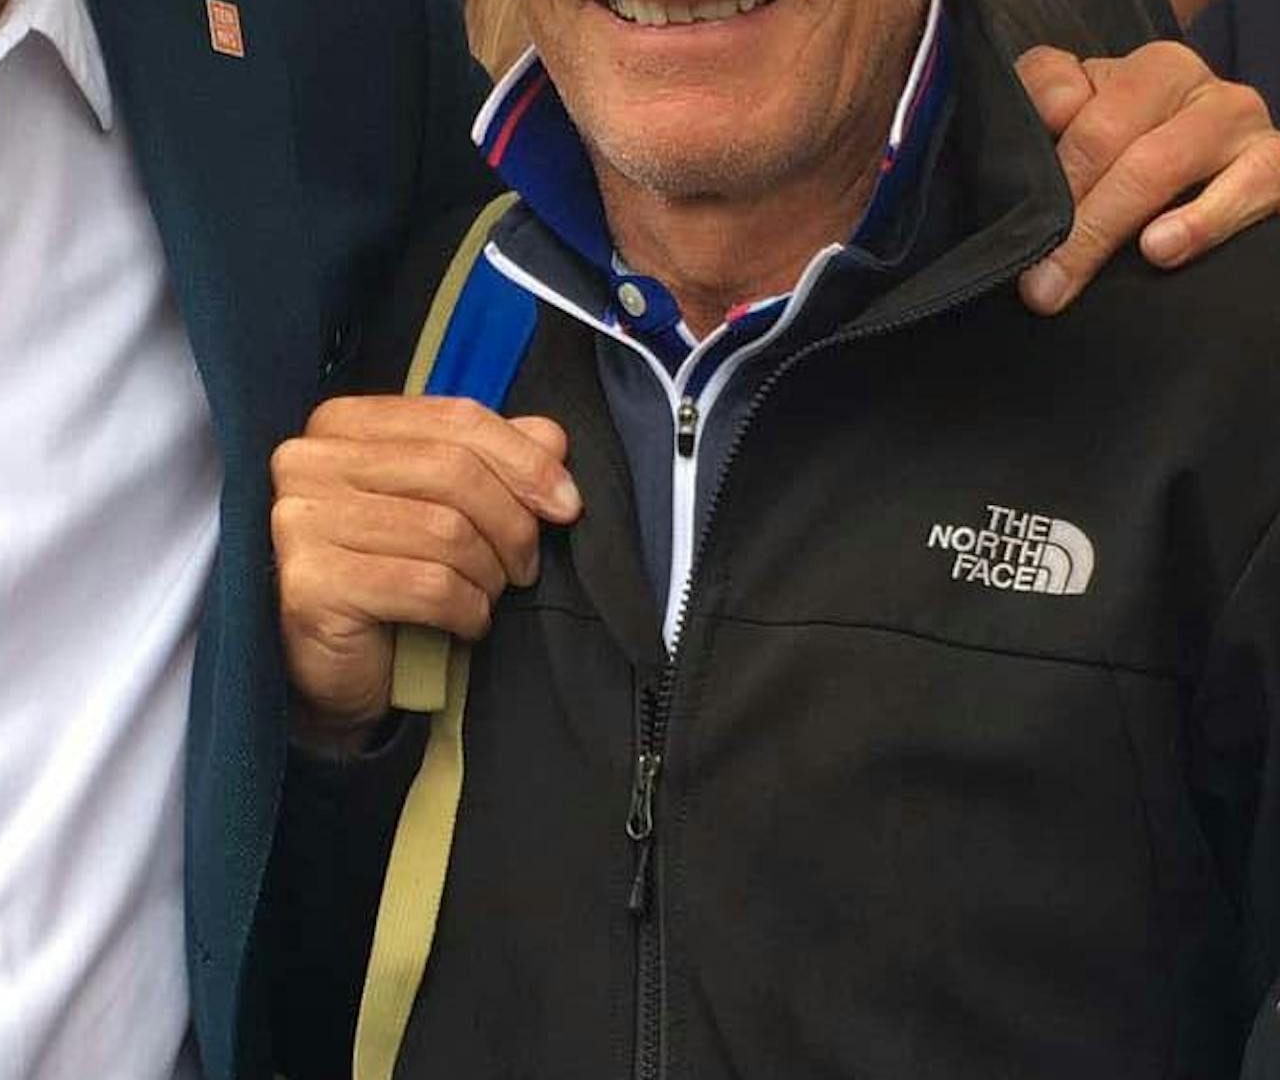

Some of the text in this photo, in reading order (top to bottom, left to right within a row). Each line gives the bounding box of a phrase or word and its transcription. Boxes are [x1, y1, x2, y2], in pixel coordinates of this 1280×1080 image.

[986, 504, 1052, 542] THE
[927, 524, 1043, 567] NORTH
[951, 553, 1034, 592] FACE
